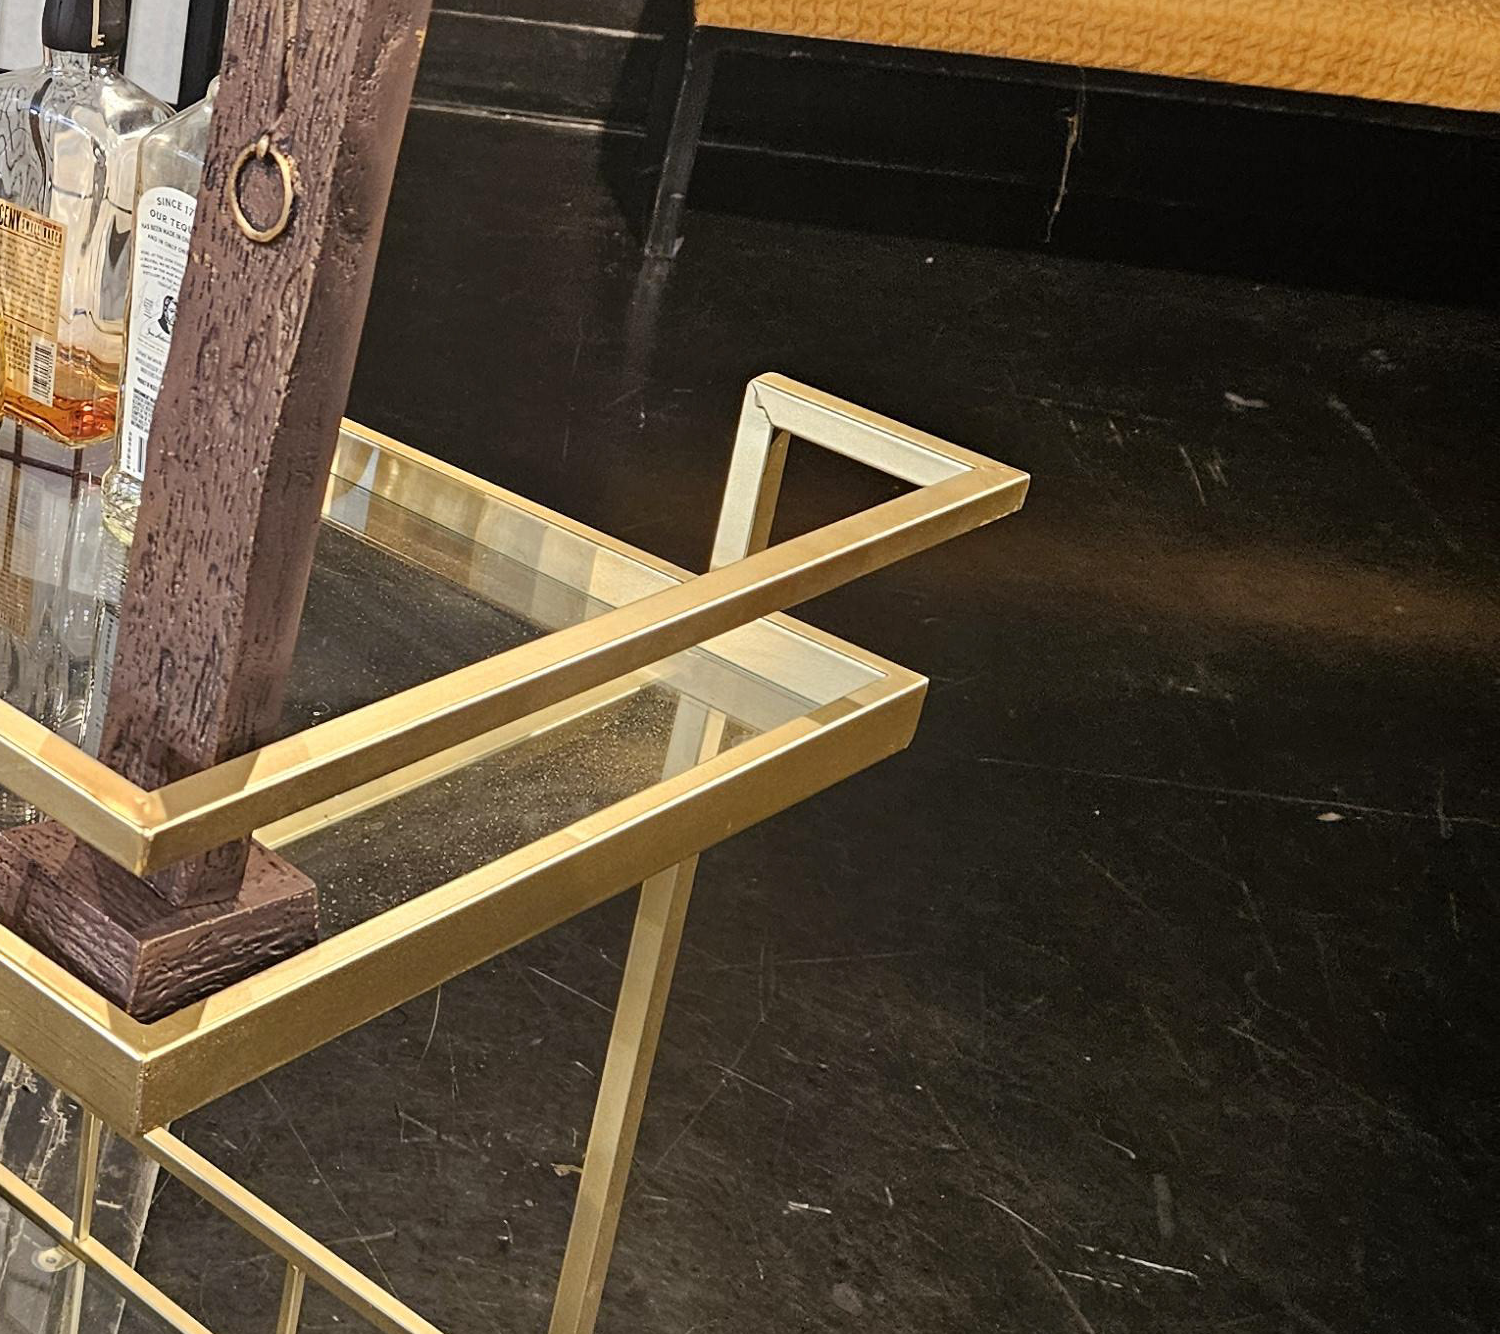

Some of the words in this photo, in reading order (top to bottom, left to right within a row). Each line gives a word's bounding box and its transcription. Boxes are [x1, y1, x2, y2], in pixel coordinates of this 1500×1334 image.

[157, 197, 182, 211] SINCE
[185, 205, 195, 217] 17
[149, 209, 168, 223] OUR
[170, 217, 192, 235] TEQU
